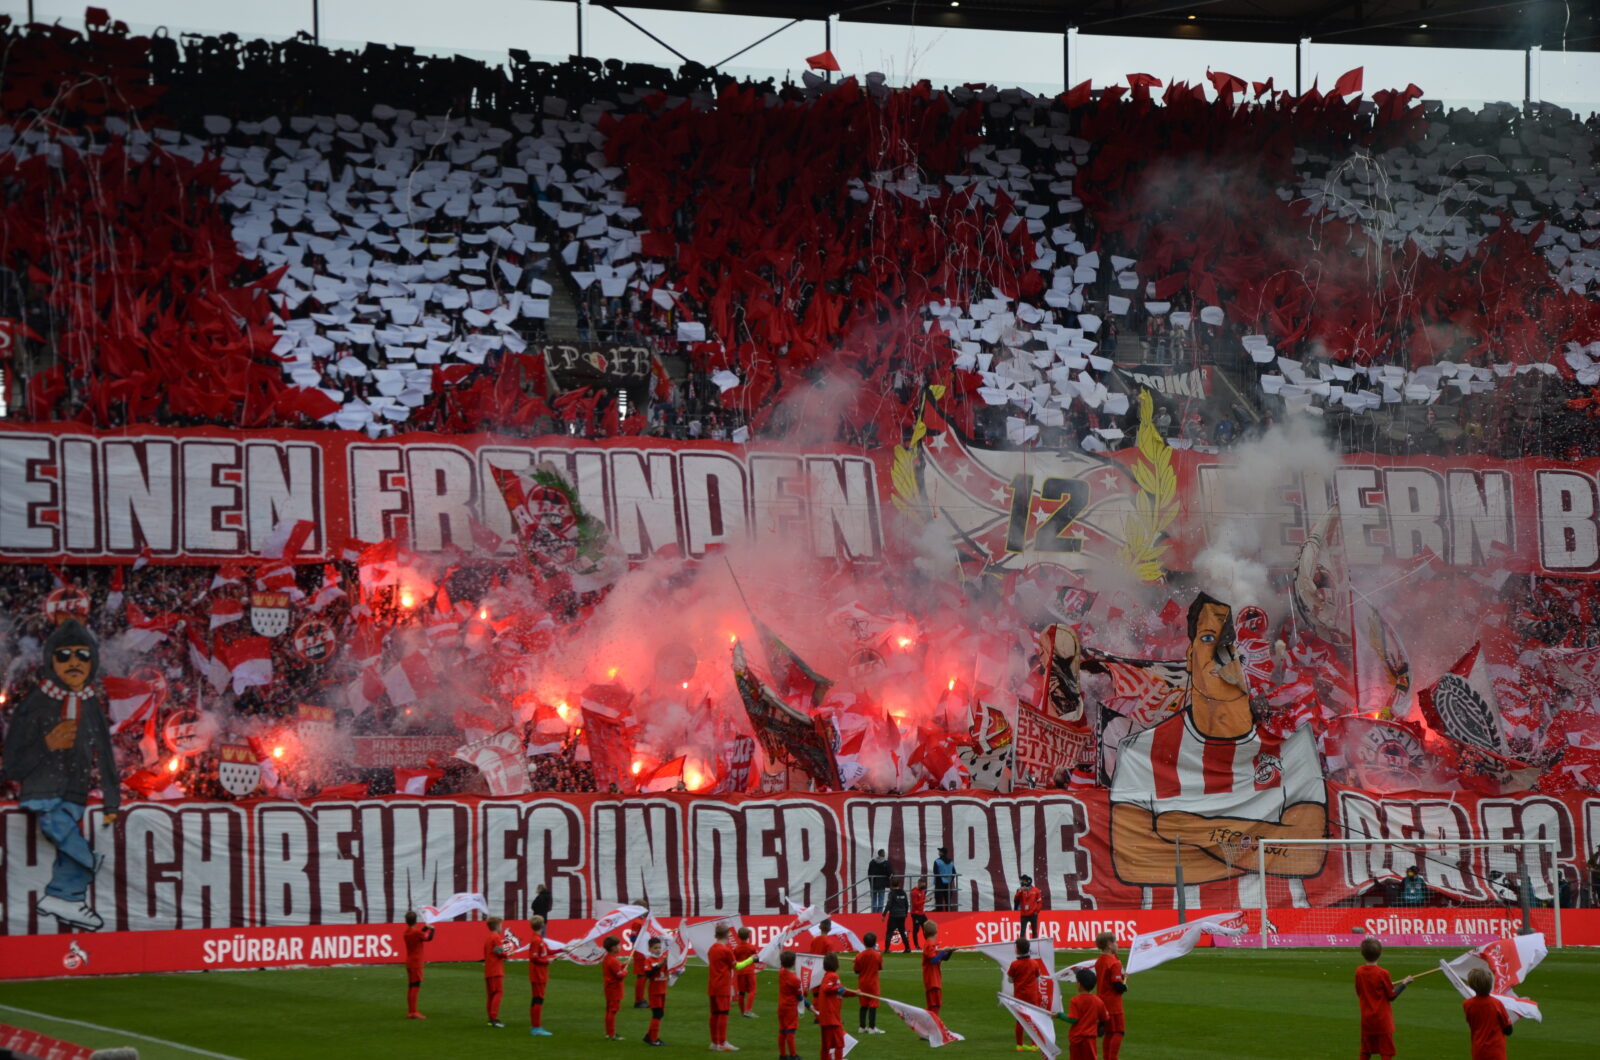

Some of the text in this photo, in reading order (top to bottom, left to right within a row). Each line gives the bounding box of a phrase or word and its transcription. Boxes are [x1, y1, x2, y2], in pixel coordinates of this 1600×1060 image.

[0, 434, 326, 557] EINEN
[1536, 468, 1600, 574] B
[1005, 474, 1090, 554] 12
[0, 806, 73, 936] H
[84, 804, 250, 931] ICH
[256, 802, 475, 928] BEIM
[478, 800, 592, 920] FC
[591, 799, 688, 919] IN
[688, 798, 842, 917] DER
[844, 796, 1098, 912] KURVE
[1337, 790, 1488, 902] DER
[1478, 795, 1583, 908] FC
[203, 934, 398, 964] SPÜRBAR ANDERS.
[1365, 915, 1448, 935] SPÜRBAR
